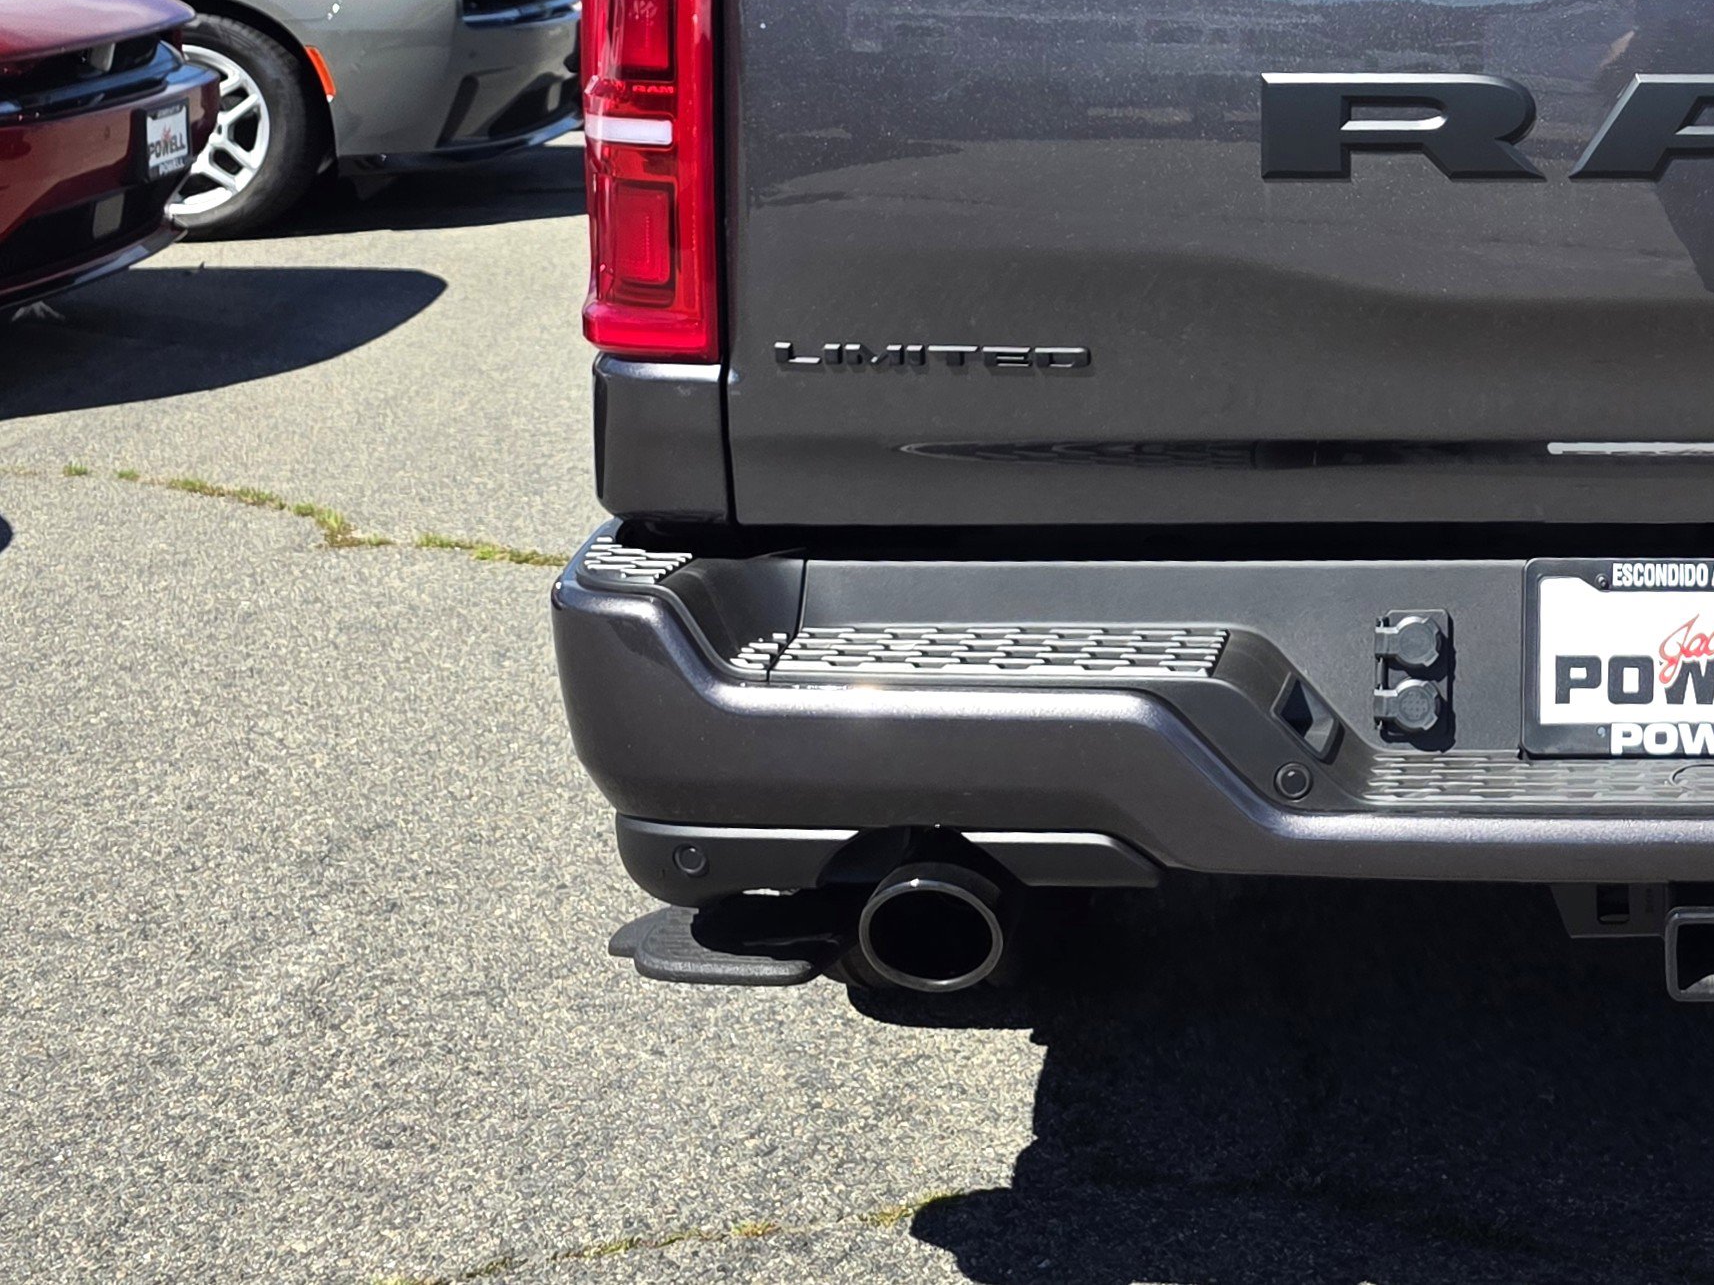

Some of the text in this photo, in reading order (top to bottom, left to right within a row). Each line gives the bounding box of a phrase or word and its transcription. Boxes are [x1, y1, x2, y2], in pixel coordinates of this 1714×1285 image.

[632, 84, 675, 94] RAM
[148, 133, 186, 158] POWELL
[774, 341, 1092, 370] LIMITED
[1611, 563, 1709, 587] ESCONDIDO
